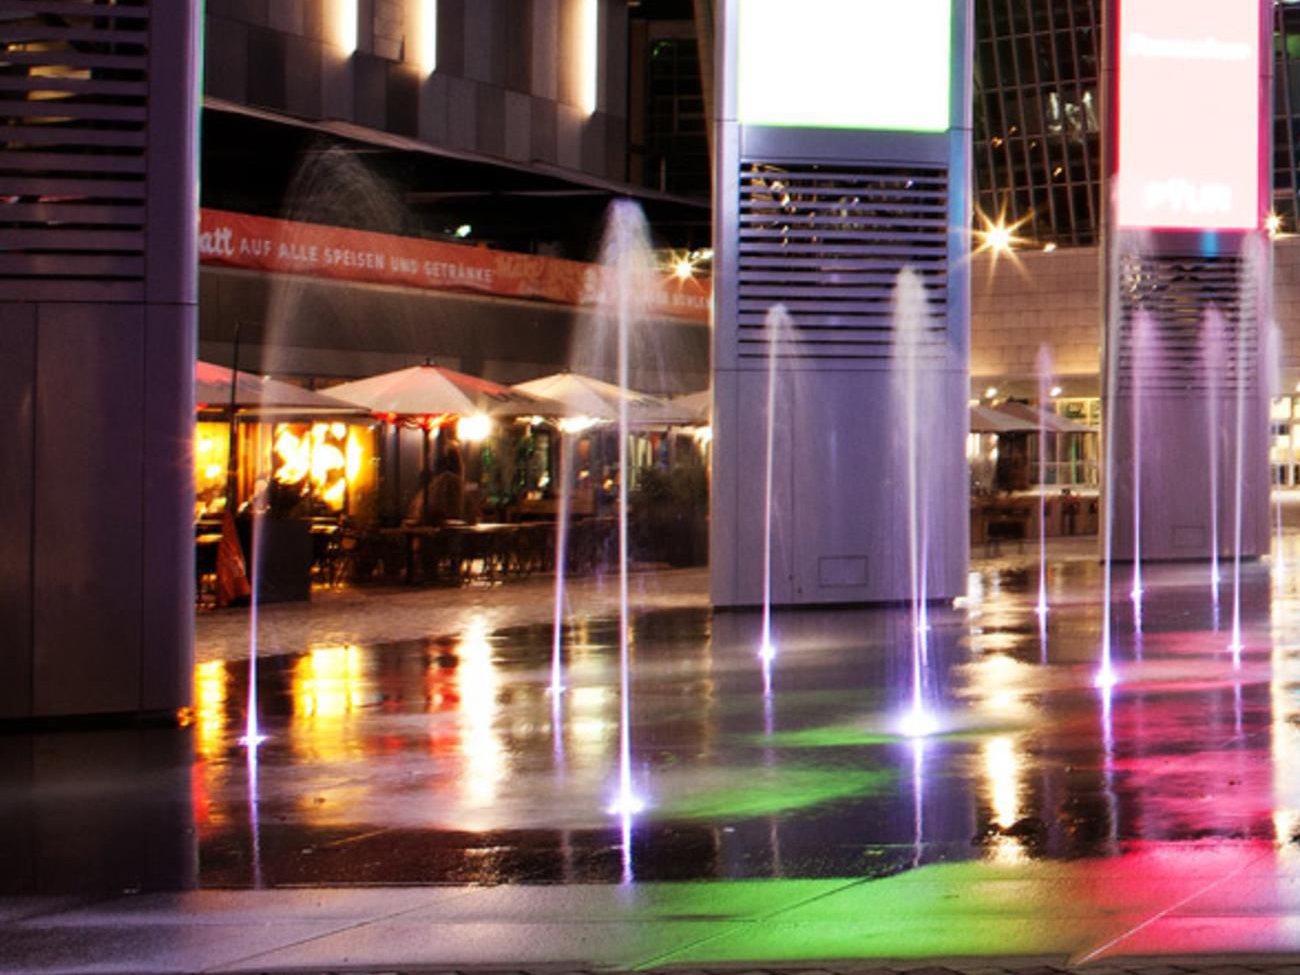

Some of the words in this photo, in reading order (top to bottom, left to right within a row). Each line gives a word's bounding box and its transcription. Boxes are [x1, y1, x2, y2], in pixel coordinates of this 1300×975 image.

[239, 238, 273, 257] AUF
[277, 242, 320, 263] ALLE
[323, 247, 385, 272] SPEISEN
[390, 255, 418, 274] UND
